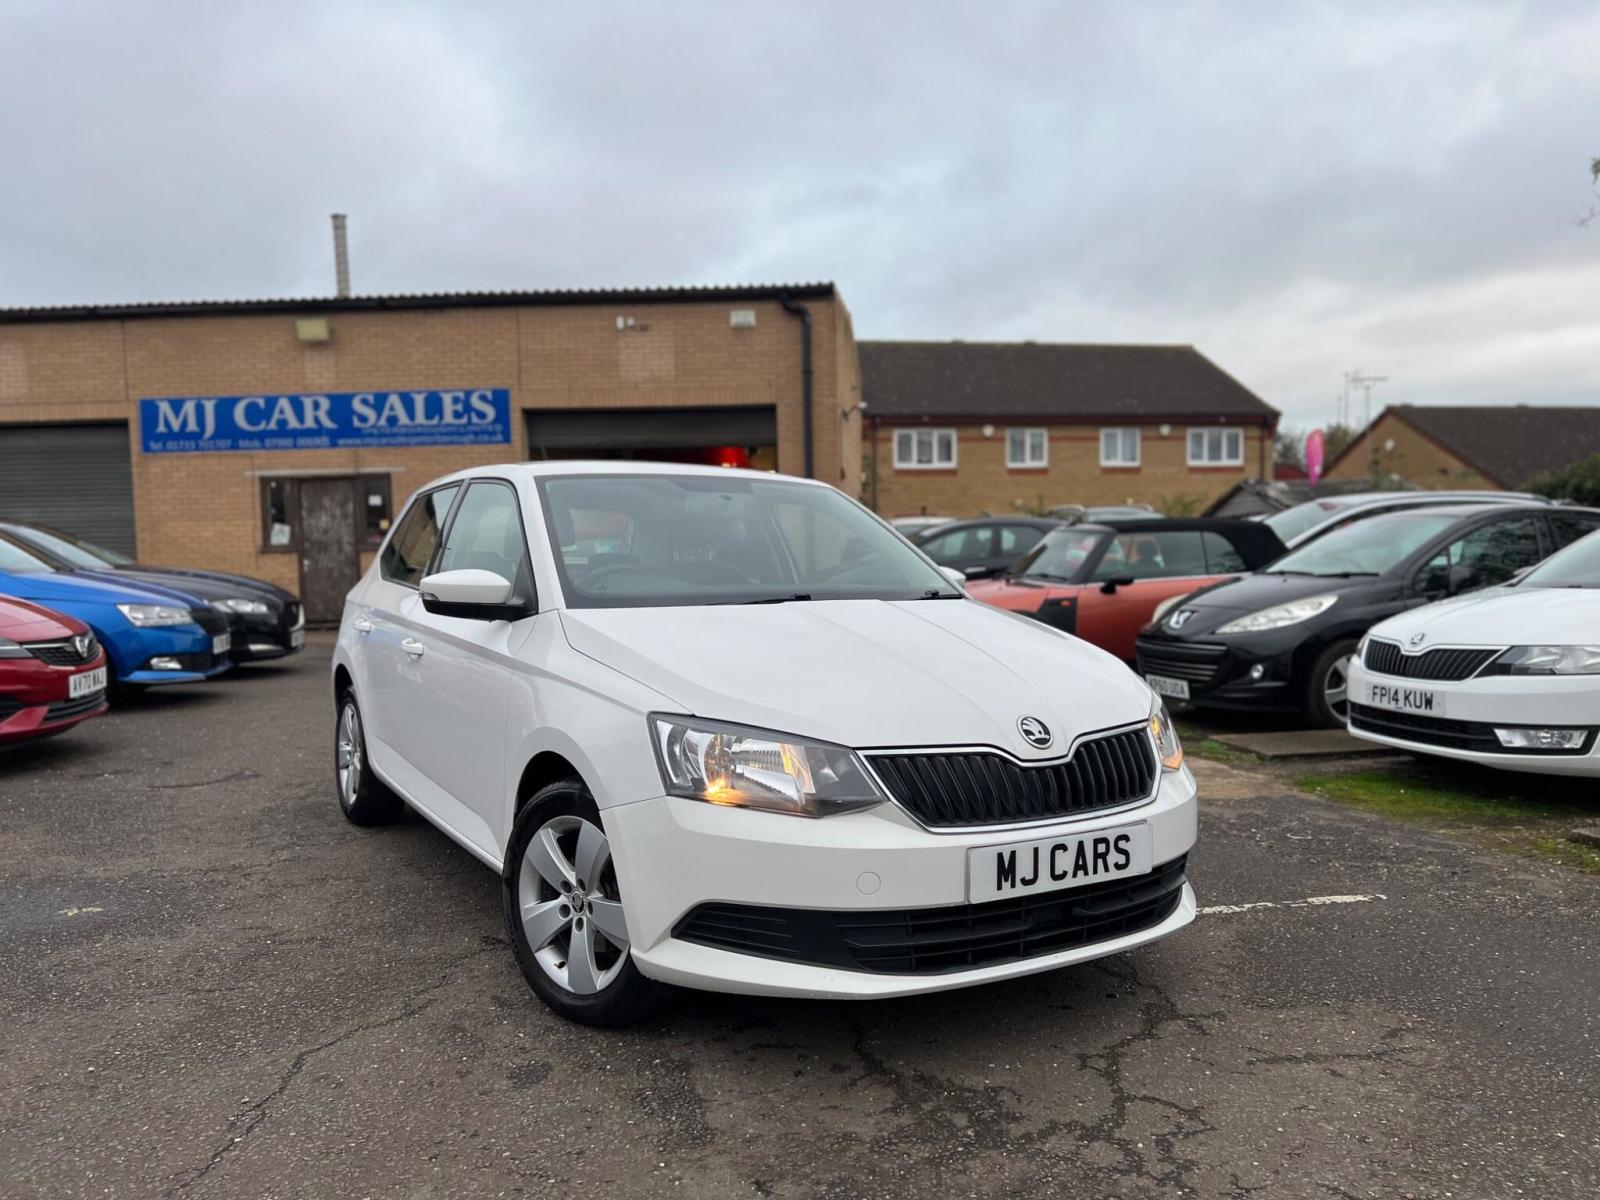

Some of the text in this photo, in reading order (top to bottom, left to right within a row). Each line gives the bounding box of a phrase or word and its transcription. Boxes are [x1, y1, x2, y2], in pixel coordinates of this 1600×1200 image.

[155, 390, 496, 439] MJ CAR SALES
[1372, 685, 1434, 711] FP14 KUW
[996, 834, 1131, 892] MJ CARS
